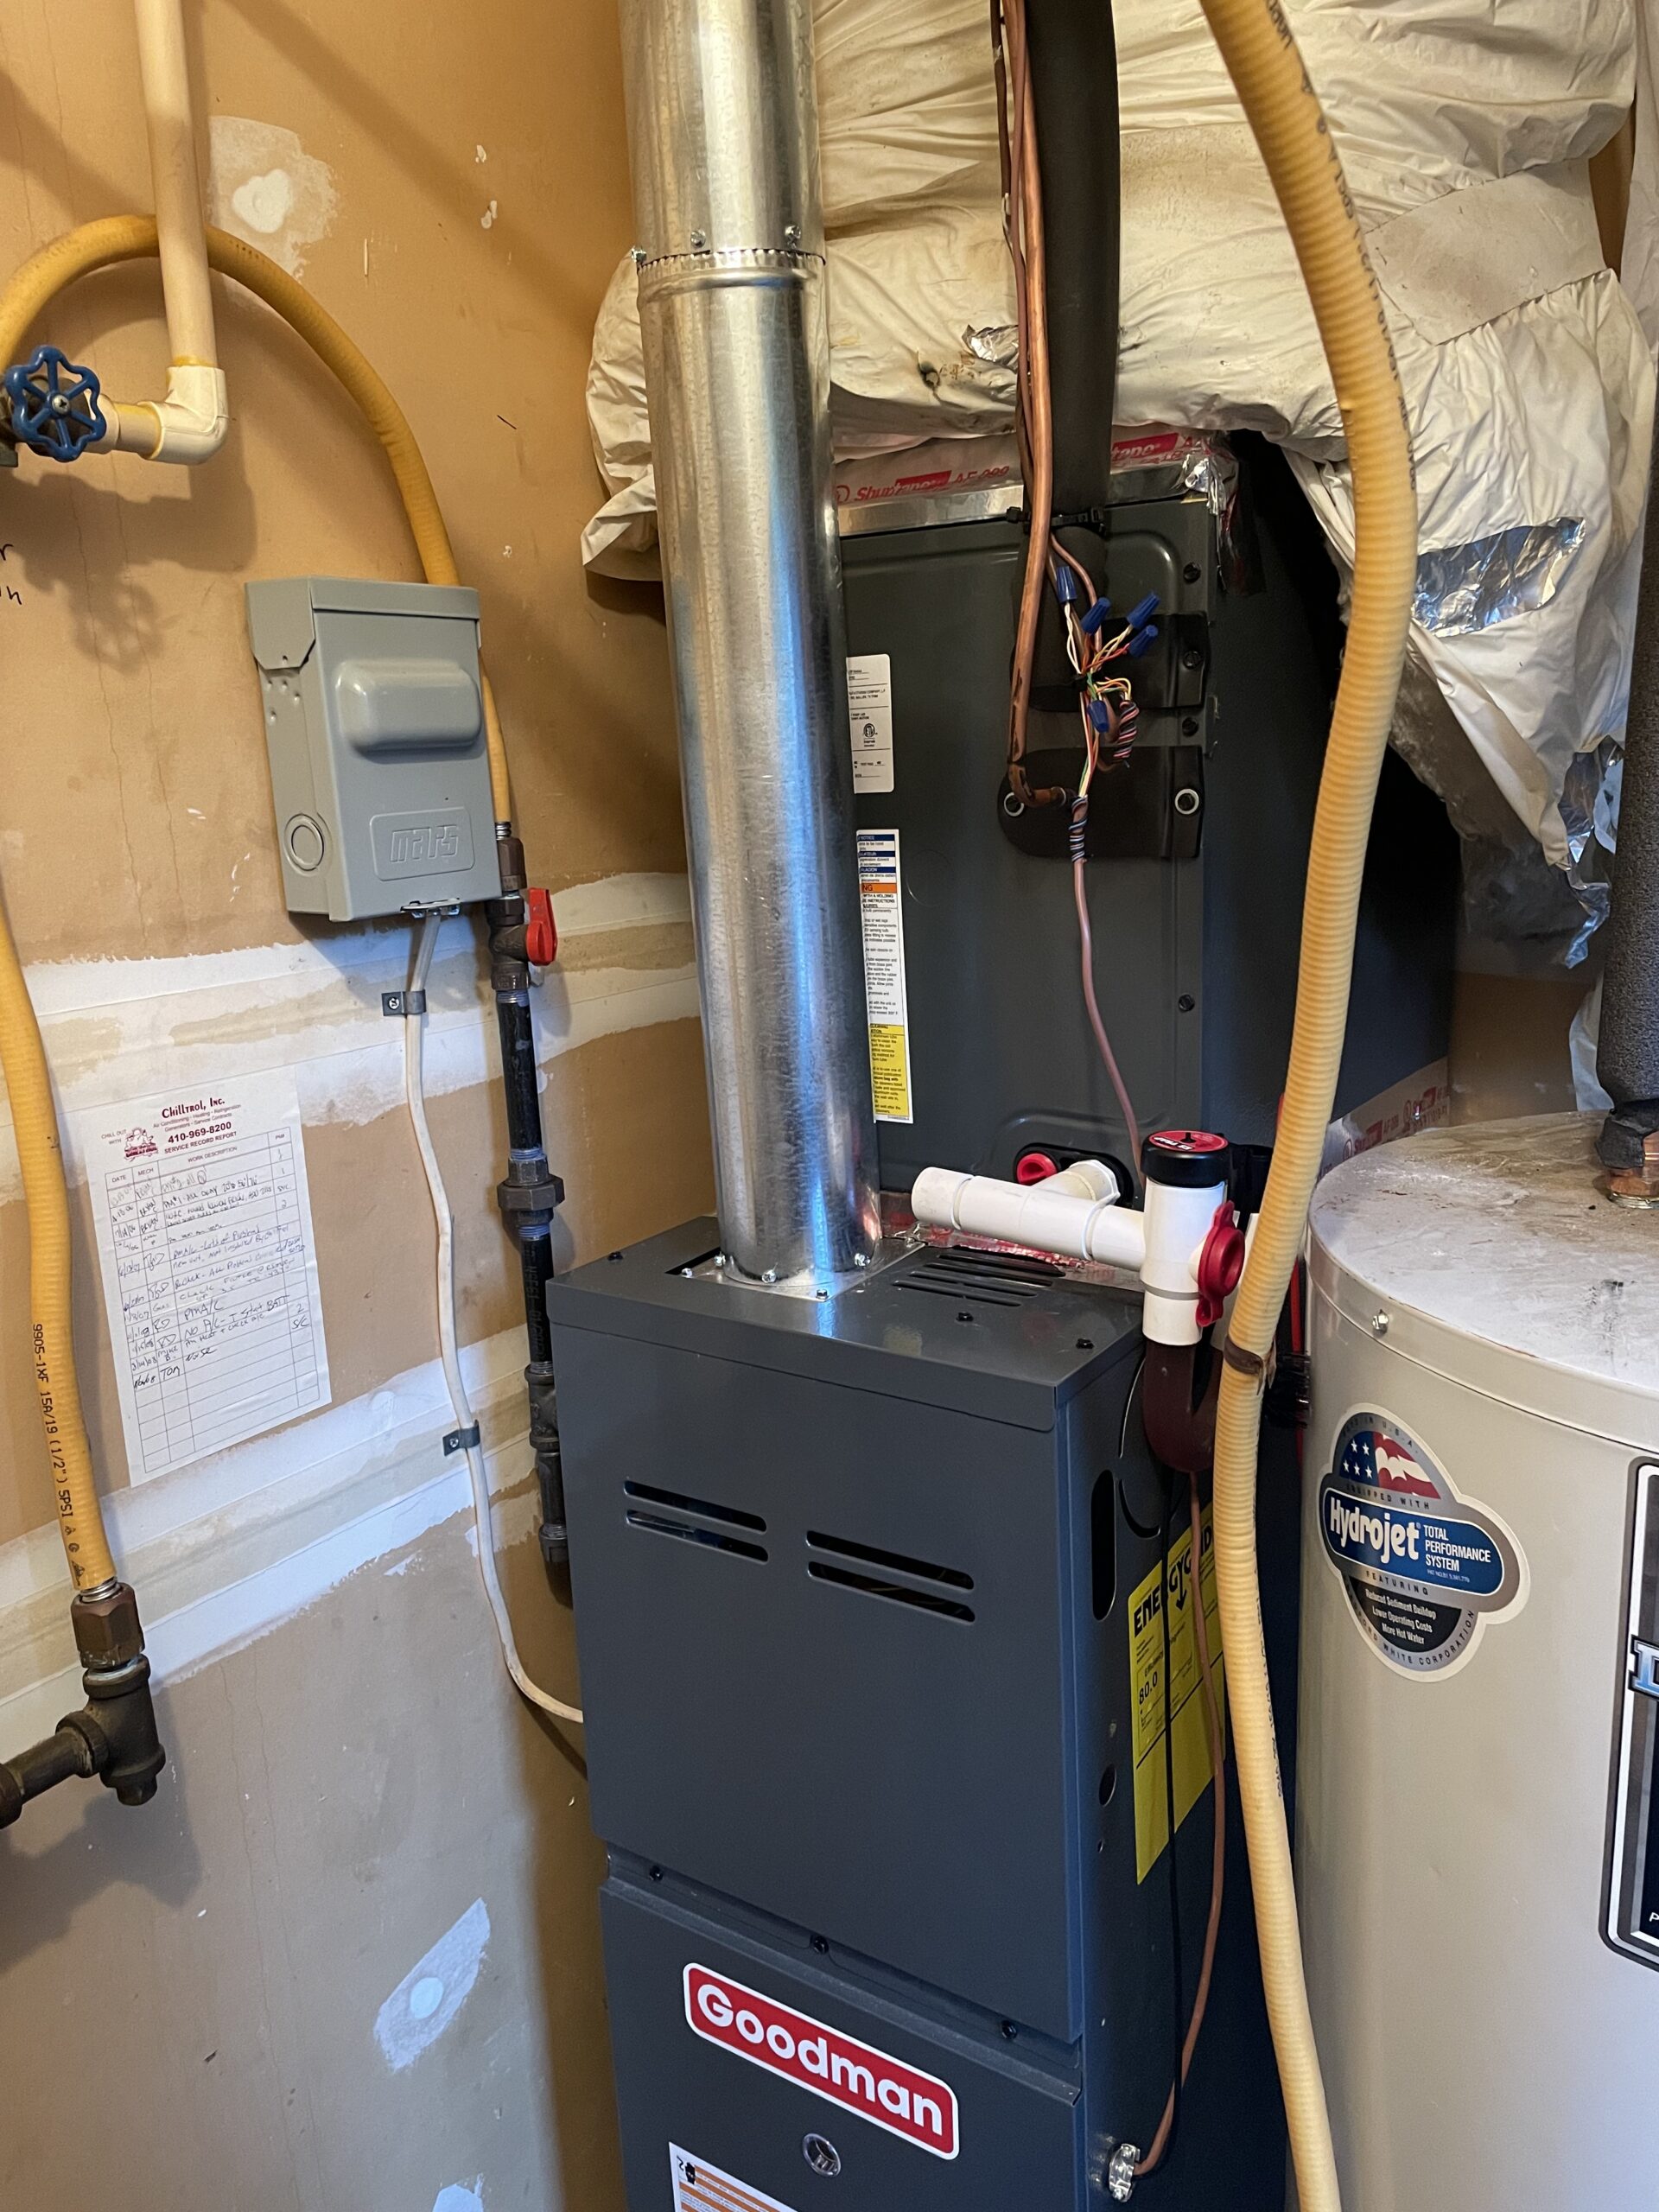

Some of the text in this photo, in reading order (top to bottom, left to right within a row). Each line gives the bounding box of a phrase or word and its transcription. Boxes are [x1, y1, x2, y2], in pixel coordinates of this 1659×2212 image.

[164, 1143, 188, 1154] SERVICE
[189, 1136, 214, 1148] RECORD
[214, 1130, 238, 1141] REPORT
[168, 1121, 232, 1145] 410-969-8200
[137, 1167, 154, 1176] MECH
[188, 1154, 204, 1163] WORK
[204, 1146, 238, 1160] DESCRIPTION
[33, 1324, 49, 1383] 9905-1XF
[40, 1391, 58, 1434] 15A/19
[58, 1490, 73, 1518] 5PSI
[1346, 1483, 1430, 1510] EQUIPPED WITH
[1329, 1496, 1420, 1565] Hydrojet
[1423, 1524, 1450, 1541] TOTAL
[1425, 1539, 1492, 1564] PERFORMANCE
[1425, 1554, 1460, 1573] SYSTEM
[1365, 1570, 1429, 1596] FEATURING
[1386, 1596, 1413, 1613] Sediment
[1372, 1605, 1433, 1633] Lower Operating Costs
[1382, 1623, 1426, 1645] More Hot Water
[1382, 1643, 1413, 1664] WHITE
[1419, 1610, 1475, 1666] CORPORATION
[1139, 1671, 1159, 1707] 80.0
[697, 1984, 943, 2137] Goodman
